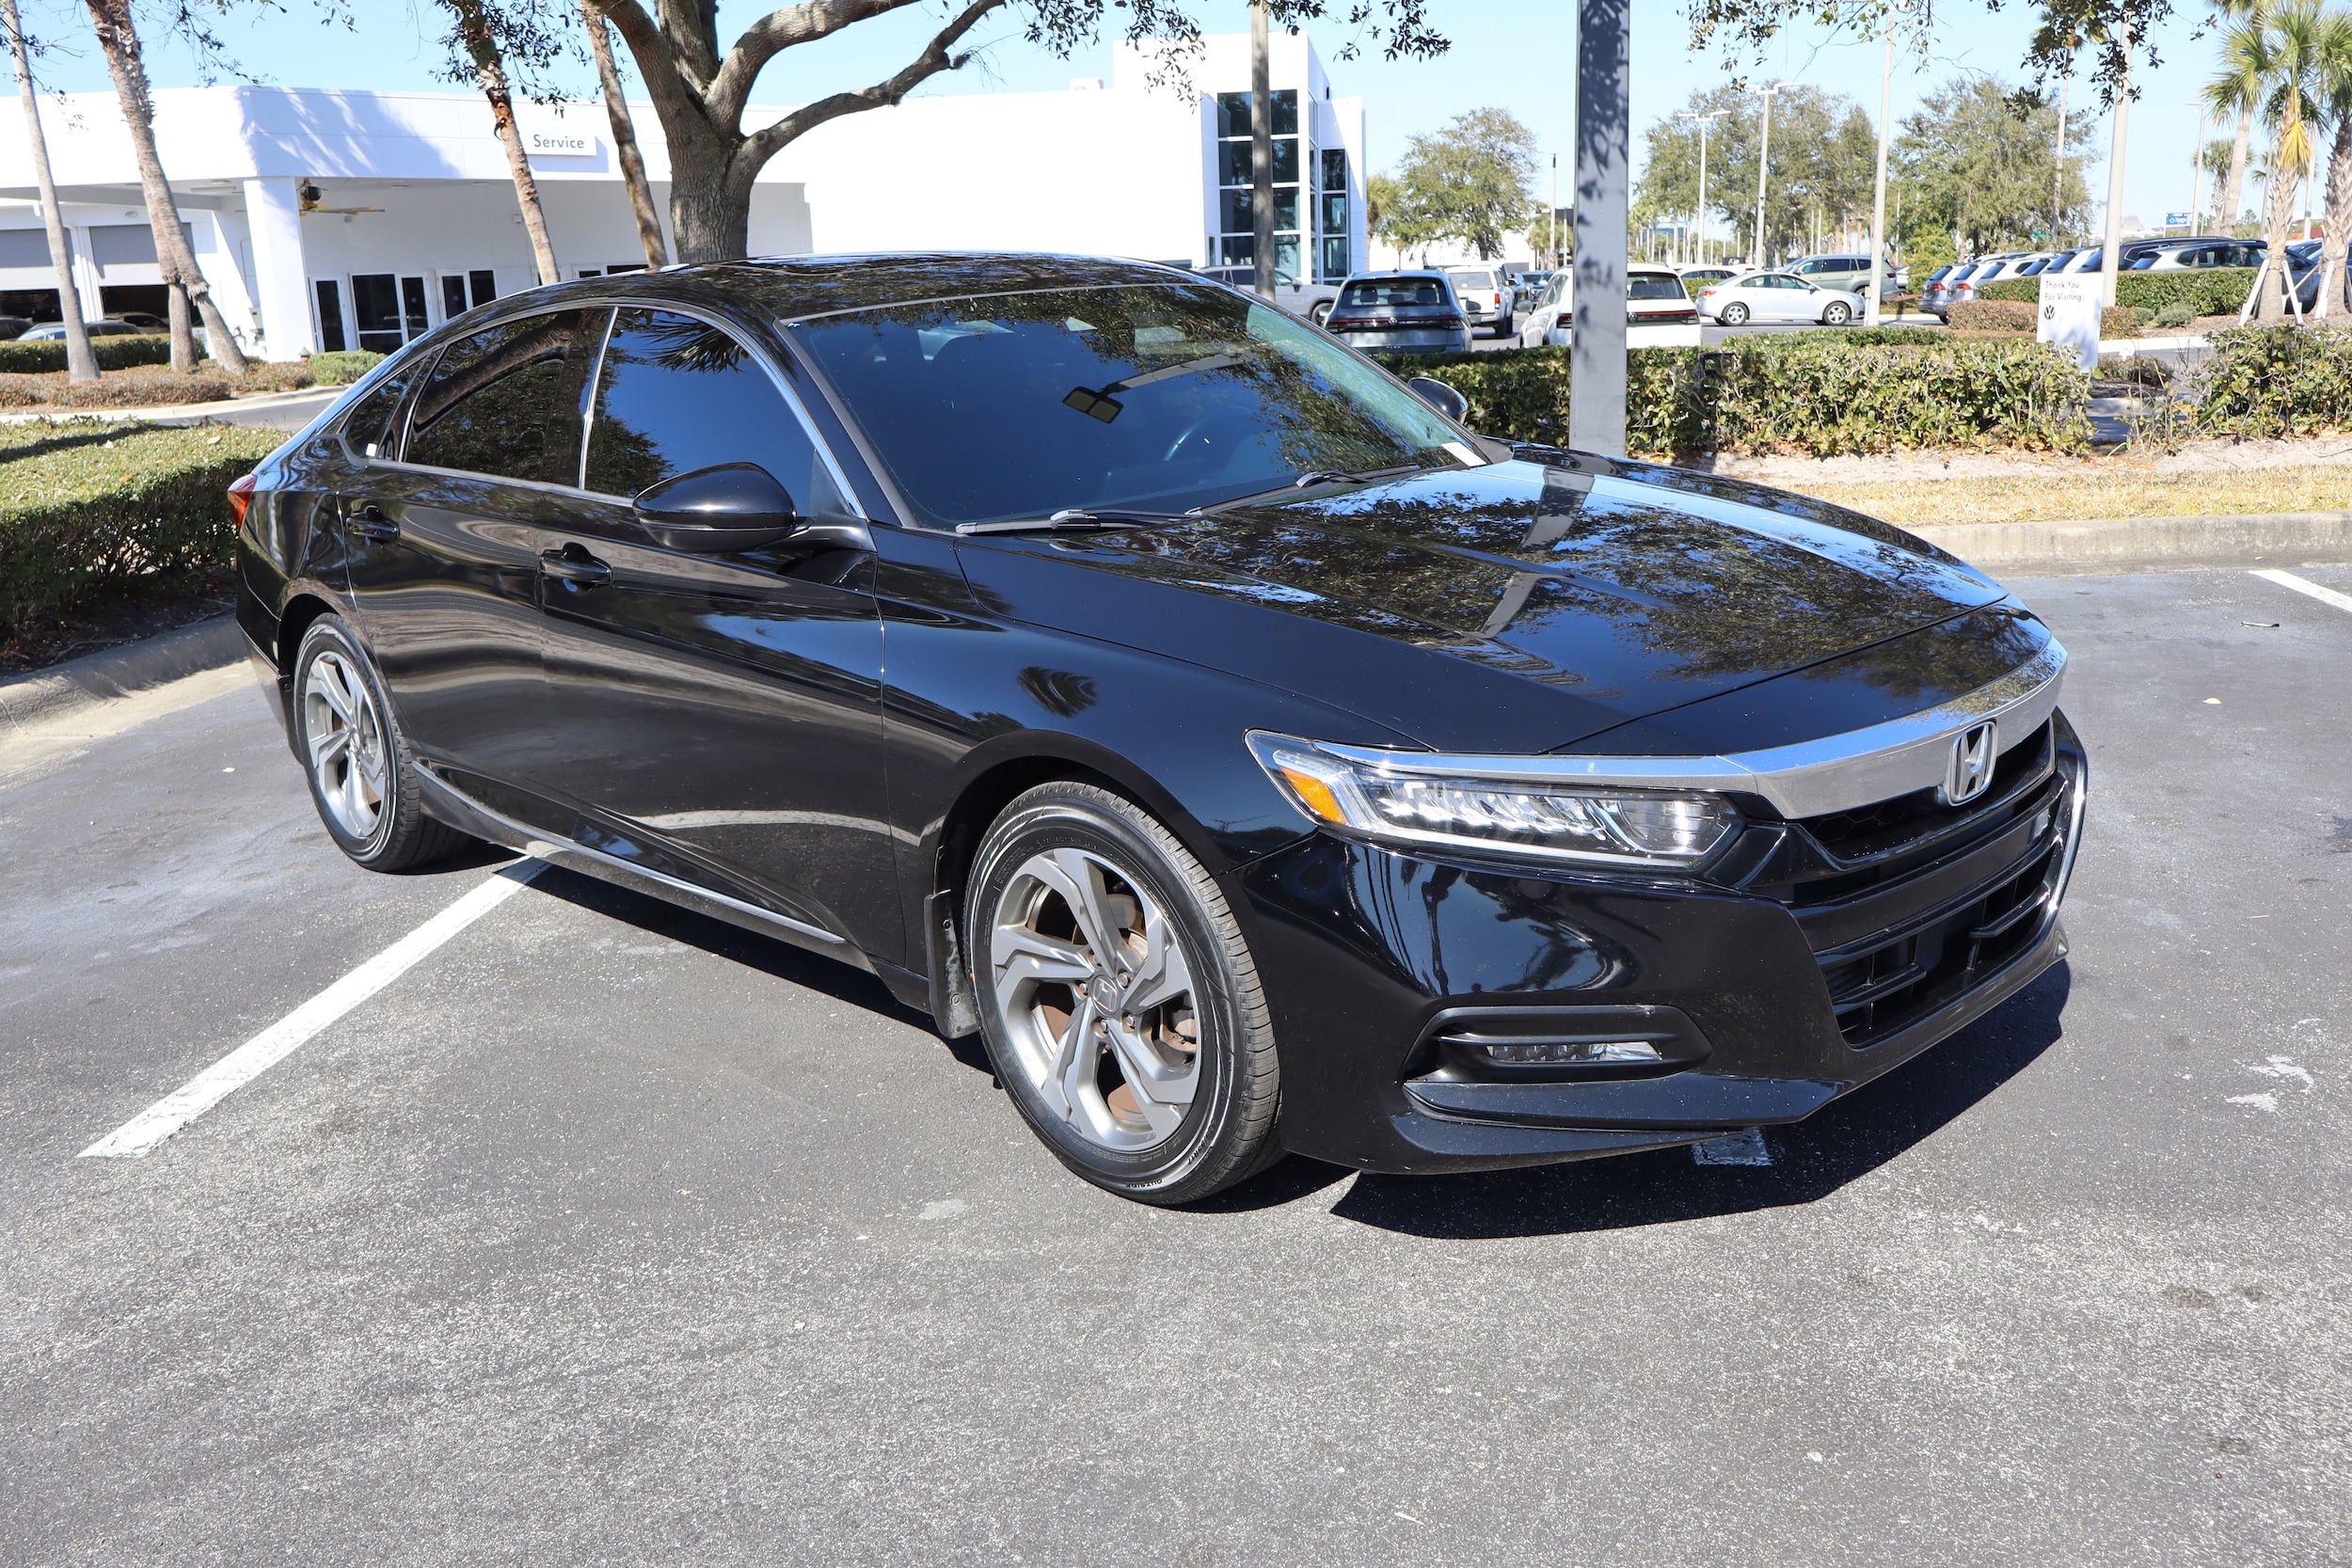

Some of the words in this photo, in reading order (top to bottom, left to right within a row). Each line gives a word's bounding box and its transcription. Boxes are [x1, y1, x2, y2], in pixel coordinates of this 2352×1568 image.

[533, 134, 584, 149] Service
[2045, 280, 2065, 289] Thank
[2067, 280, 2080, 289] You
[2044, 293, 2055, 301] For
[2057, 293, 2082, 302] Visiting
